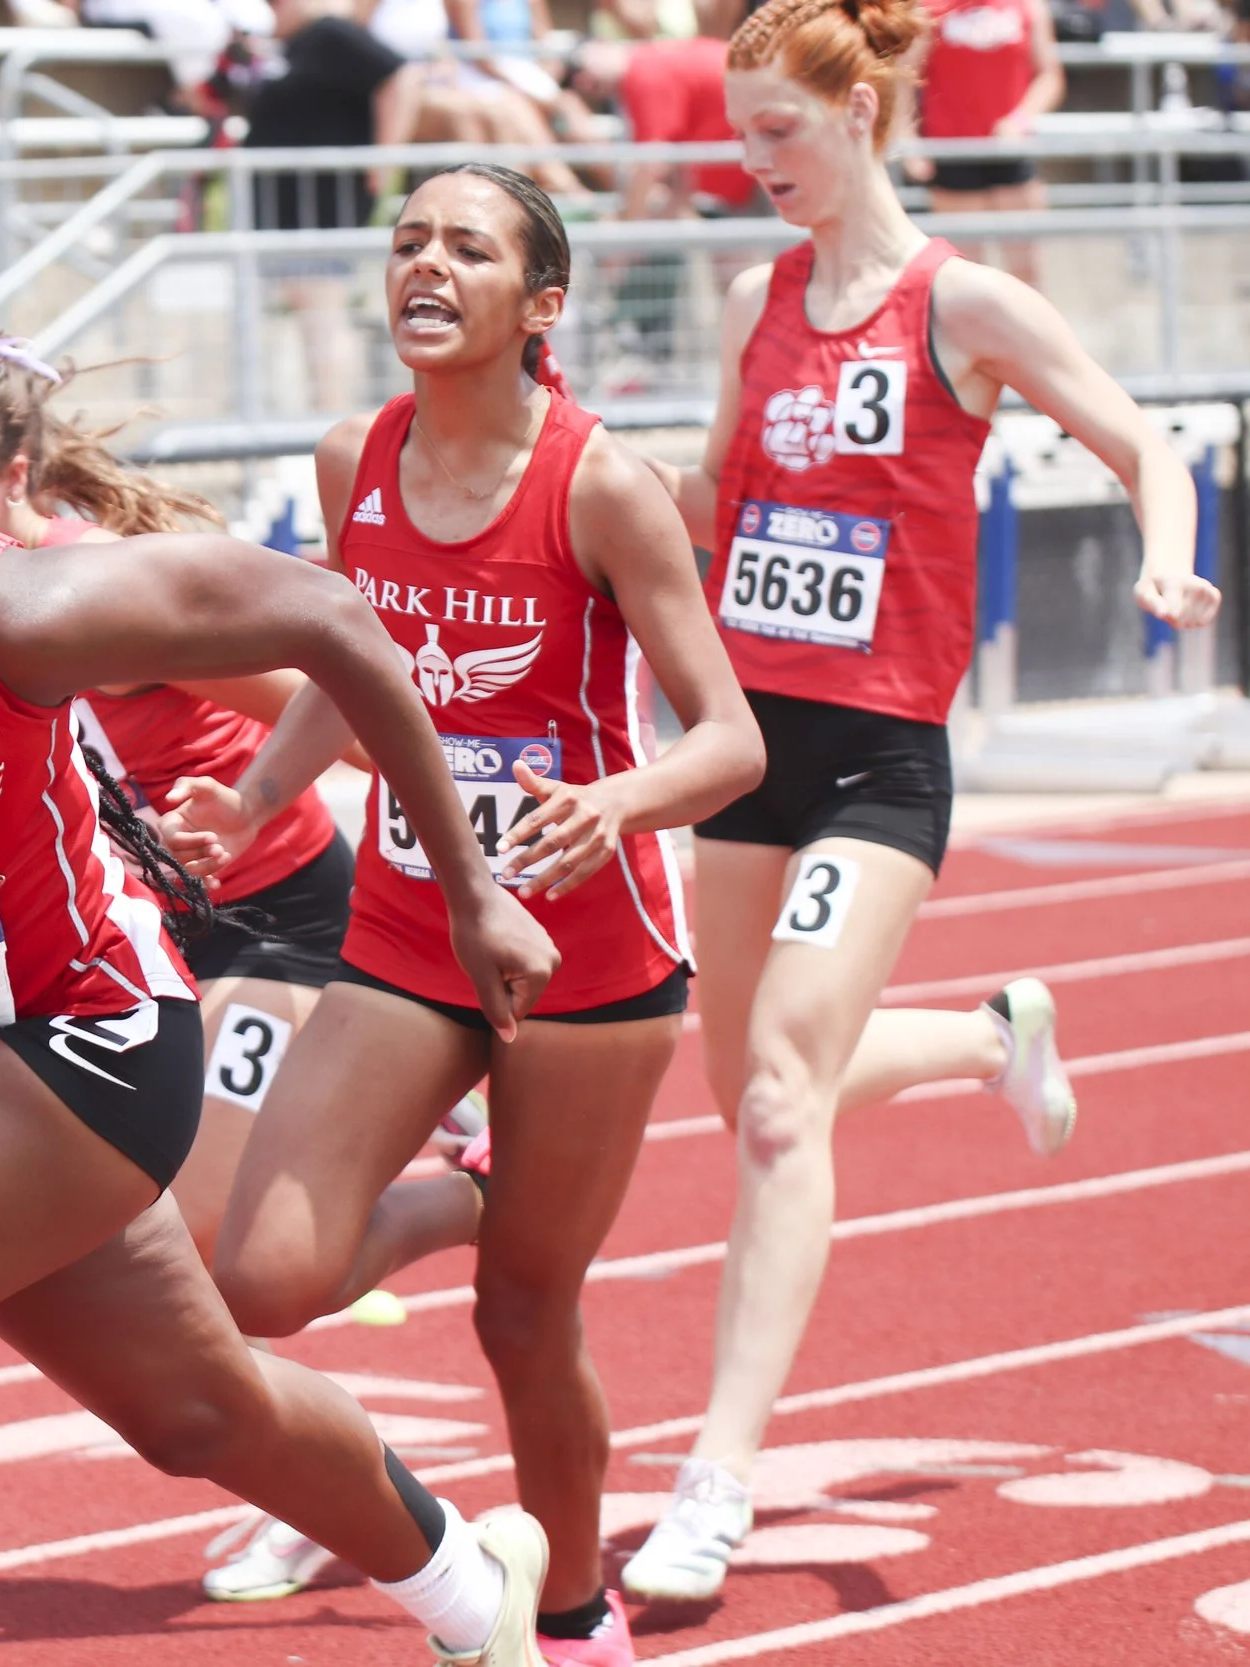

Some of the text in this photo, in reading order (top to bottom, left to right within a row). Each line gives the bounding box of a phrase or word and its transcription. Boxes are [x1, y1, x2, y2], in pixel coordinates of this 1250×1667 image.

[845, 368, 890, 445] 3
[766, 511, 840, 547] ZERO
[354, 566, 547, 627] PARK HILL
[734, 549, 866, 623] 5636
[789, 862, 841, 932] 3
[219, 1016, 274, 1096] 3
